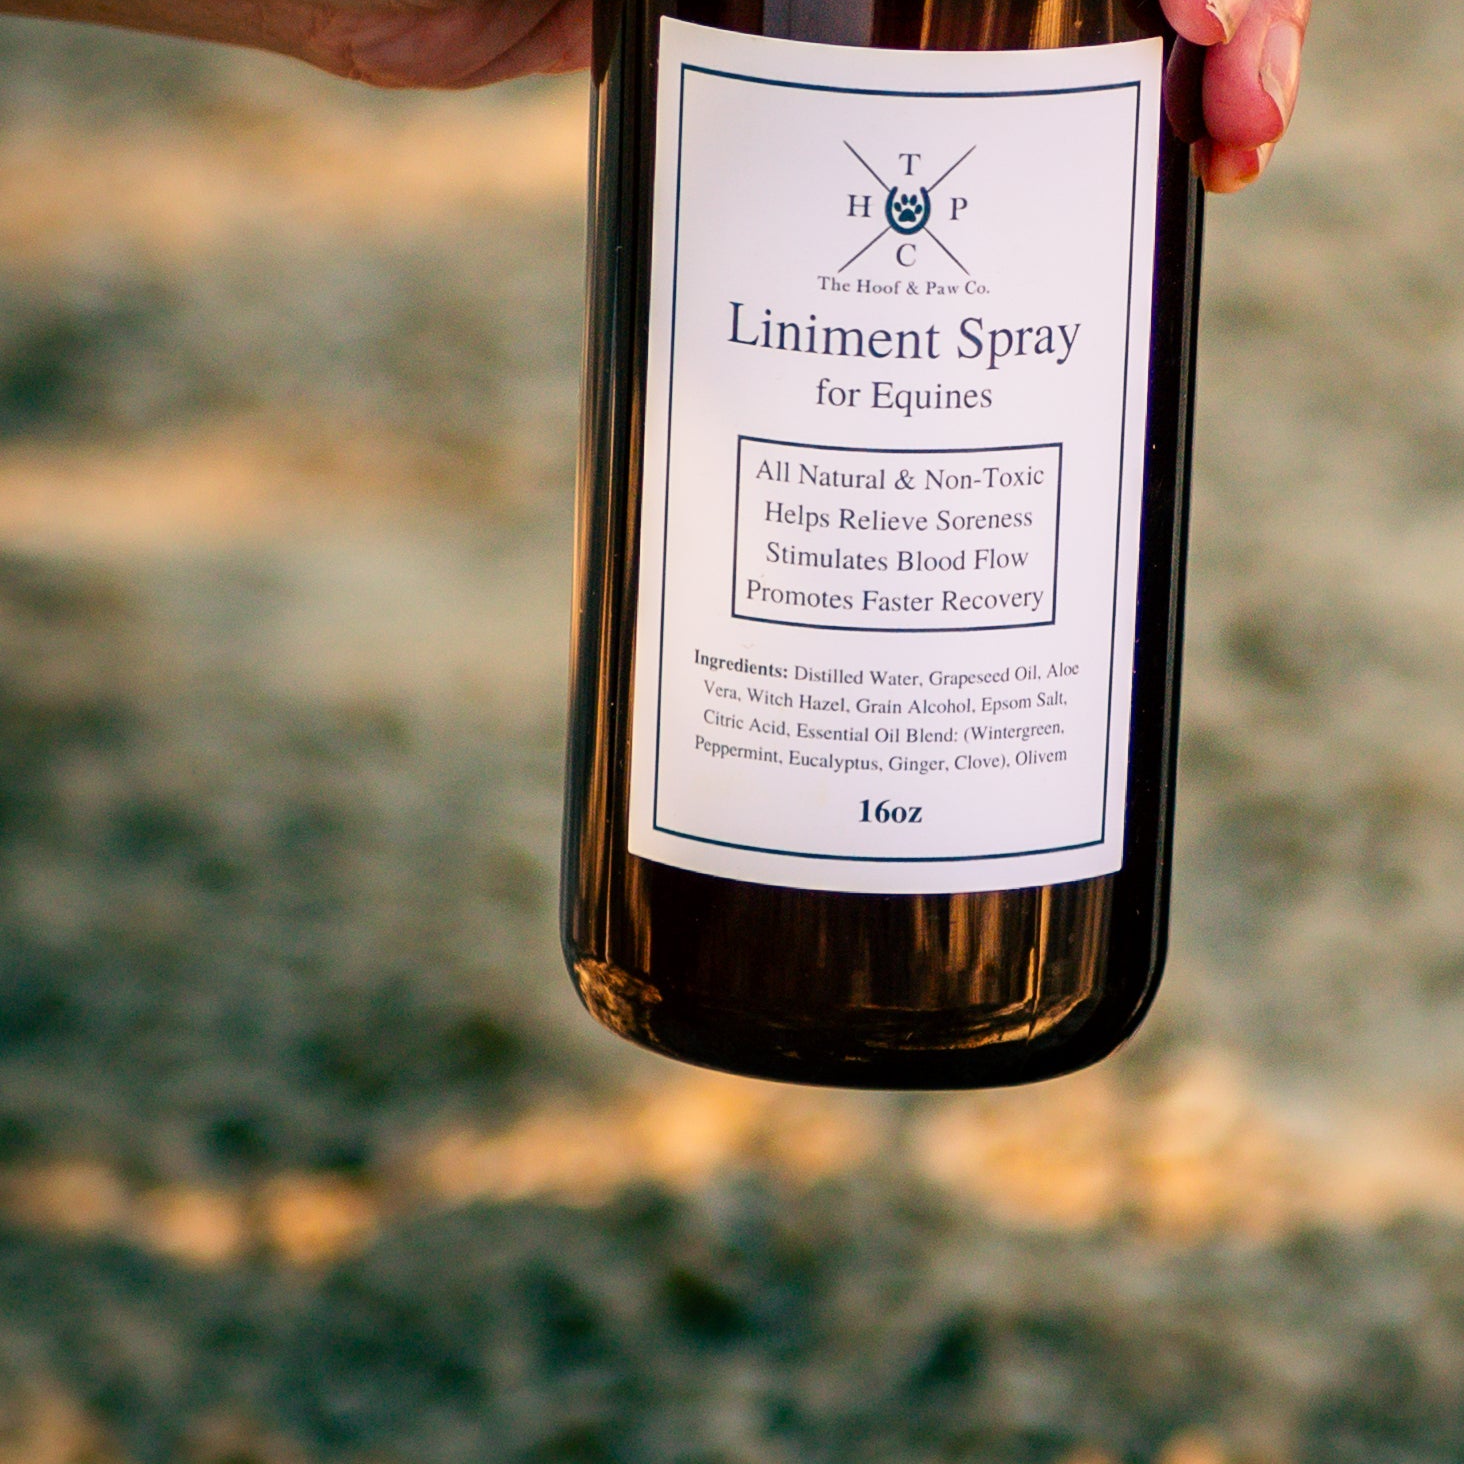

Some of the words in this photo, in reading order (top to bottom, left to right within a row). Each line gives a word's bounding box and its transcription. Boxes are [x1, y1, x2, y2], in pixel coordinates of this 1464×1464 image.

[898, 152, 922, 177] T
[846, 193, 873, 219] H
[949, 196, 969, 221] P
[895, 242, 917, 268] C
[816, 275, 851, 293] The
[856, 278, 902, 296] Hoof
[905, 280, 920, 296] &
[925, 280, 960, 296] Paw
[964, 279, 990, 296] Co.
[727, 300, 941, 360] Liniment
[956, 316, 1082, 371] Spray
[815, 377, 862, 408] for
[870, 380, 993, 418] Equines
[755, 459, 790, 483] All
[797, 463, 886, 490] Natural
[893, 468, 916, 491] &
[924, 465, 1045, 491] Non-Toxic
[764, 500, 830, 533] Helps
[838, 507, 928, 532] Relieve
[935, 509, 1033, 532] Soreness
[765, 541, 889, 572] Stimulates
[896, 549, 966, 572] Blood
[973, 547, 1030, 571] Flow
[746, 578, 854, 610] Promotes
[861, 589, 935, 613] Faster
[940, 590, 1045, 613] Recovery
[694, 648, 788, 680] Ingredients:
[794, 664, 864, 685] Distilled
[868, 669, 924, 688] Water,
[928, 666, 1010, 690] Grapeseed
[1014, 664, 1042, 682] Oil,
[1046, 661, 1080, 679] Aloe
[703, 679, 742, 703] Vera,
[746, 687, 794, 708] Witch
[799, 693, 851, 714] Hazel,
[855, 697, 903, 715] Grain
[907, 697, 976, 715] Alcohol,
[981, 696, 1032, 716] Epsom
[1036, 690, 1068, 708] Salt,
[703, 708, 744, 730] Citric
[748, 717, 791, 738] Acid,
[796, 722, 869, 743] Essential
[874, 727, 900, 744] Oil
[905, 726, 959, 744] Blend:
[963, 722, 1065, 744] (Wintergreen,
[694, 734, 784, 765] Peppermint,
[788, 749, 884, 774] Eucalyptus,
[888, 755, 950, 776] Ginger,
[953, 753, 1011, 771] Clove),
[1014, 749, 1068, 767] Olivem
[858, 798, 923, 825] 16oz
